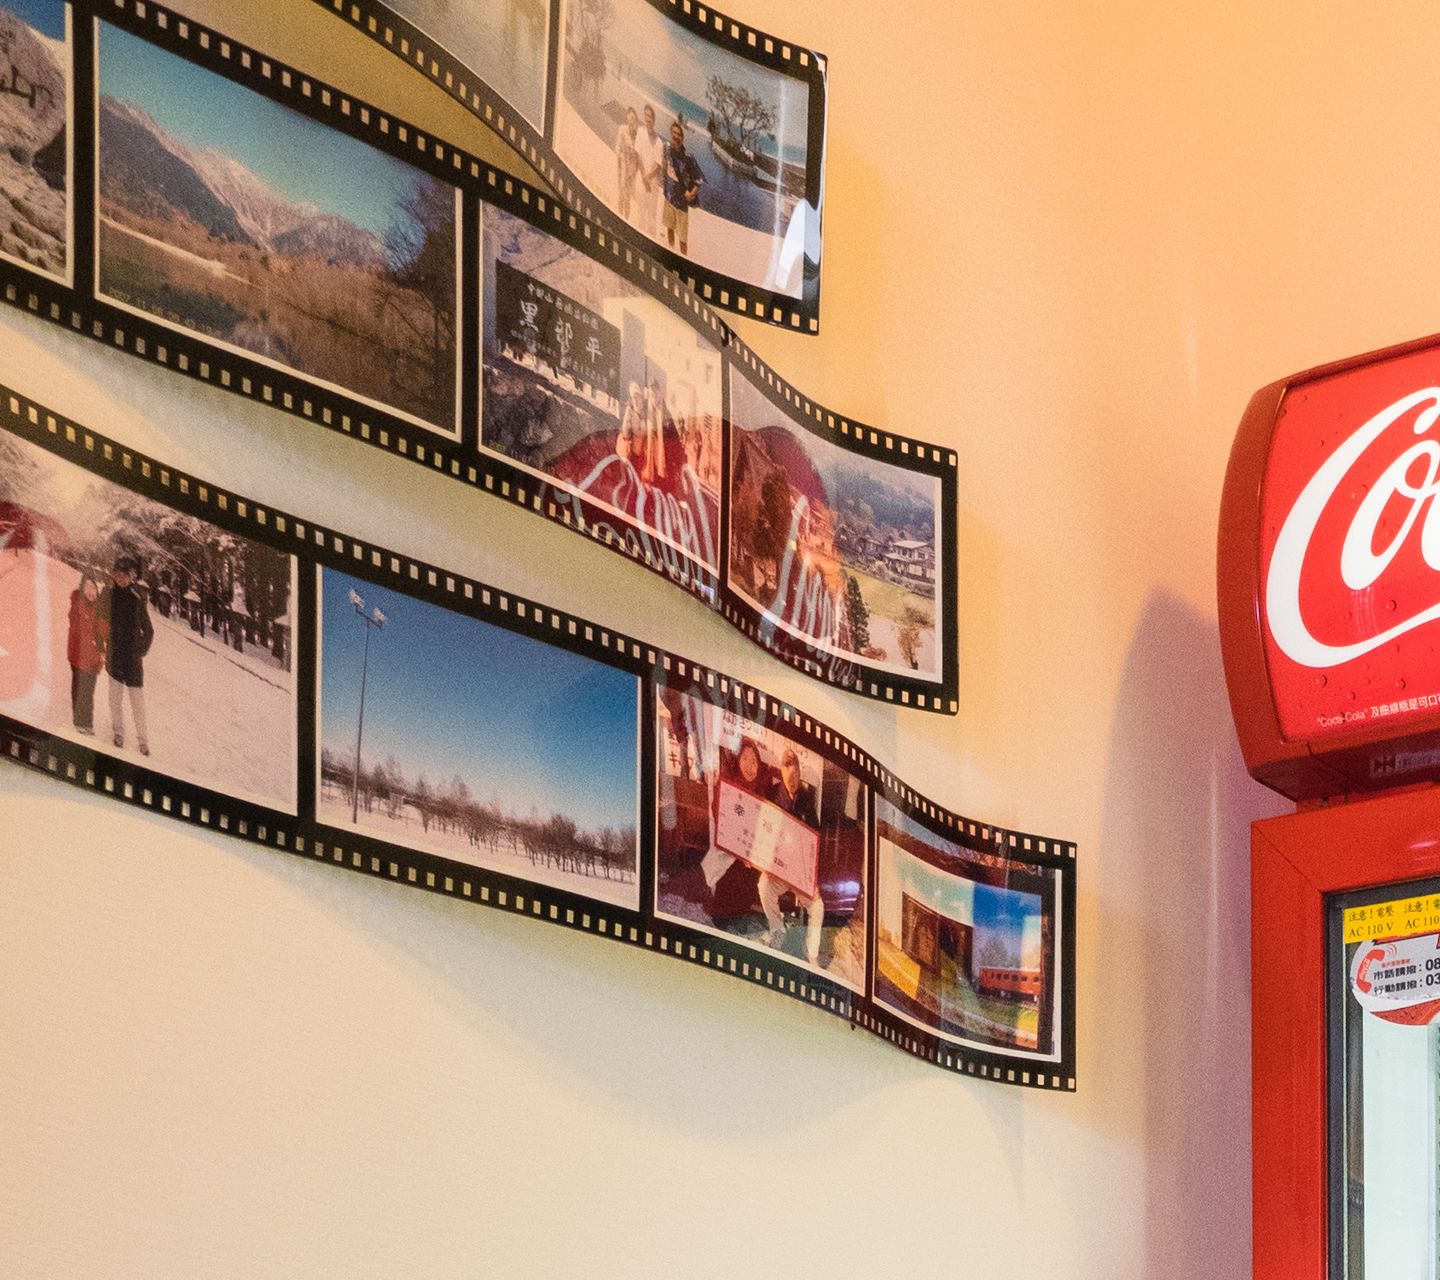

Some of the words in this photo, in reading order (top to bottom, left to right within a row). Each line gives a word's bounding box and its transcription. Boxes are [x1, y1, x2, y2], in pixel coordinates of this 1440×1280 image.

[1348, 927, 1364, 938] AC
[1386, 921, 1394, 931] V
[1404, 918, 1420, 929] AC
